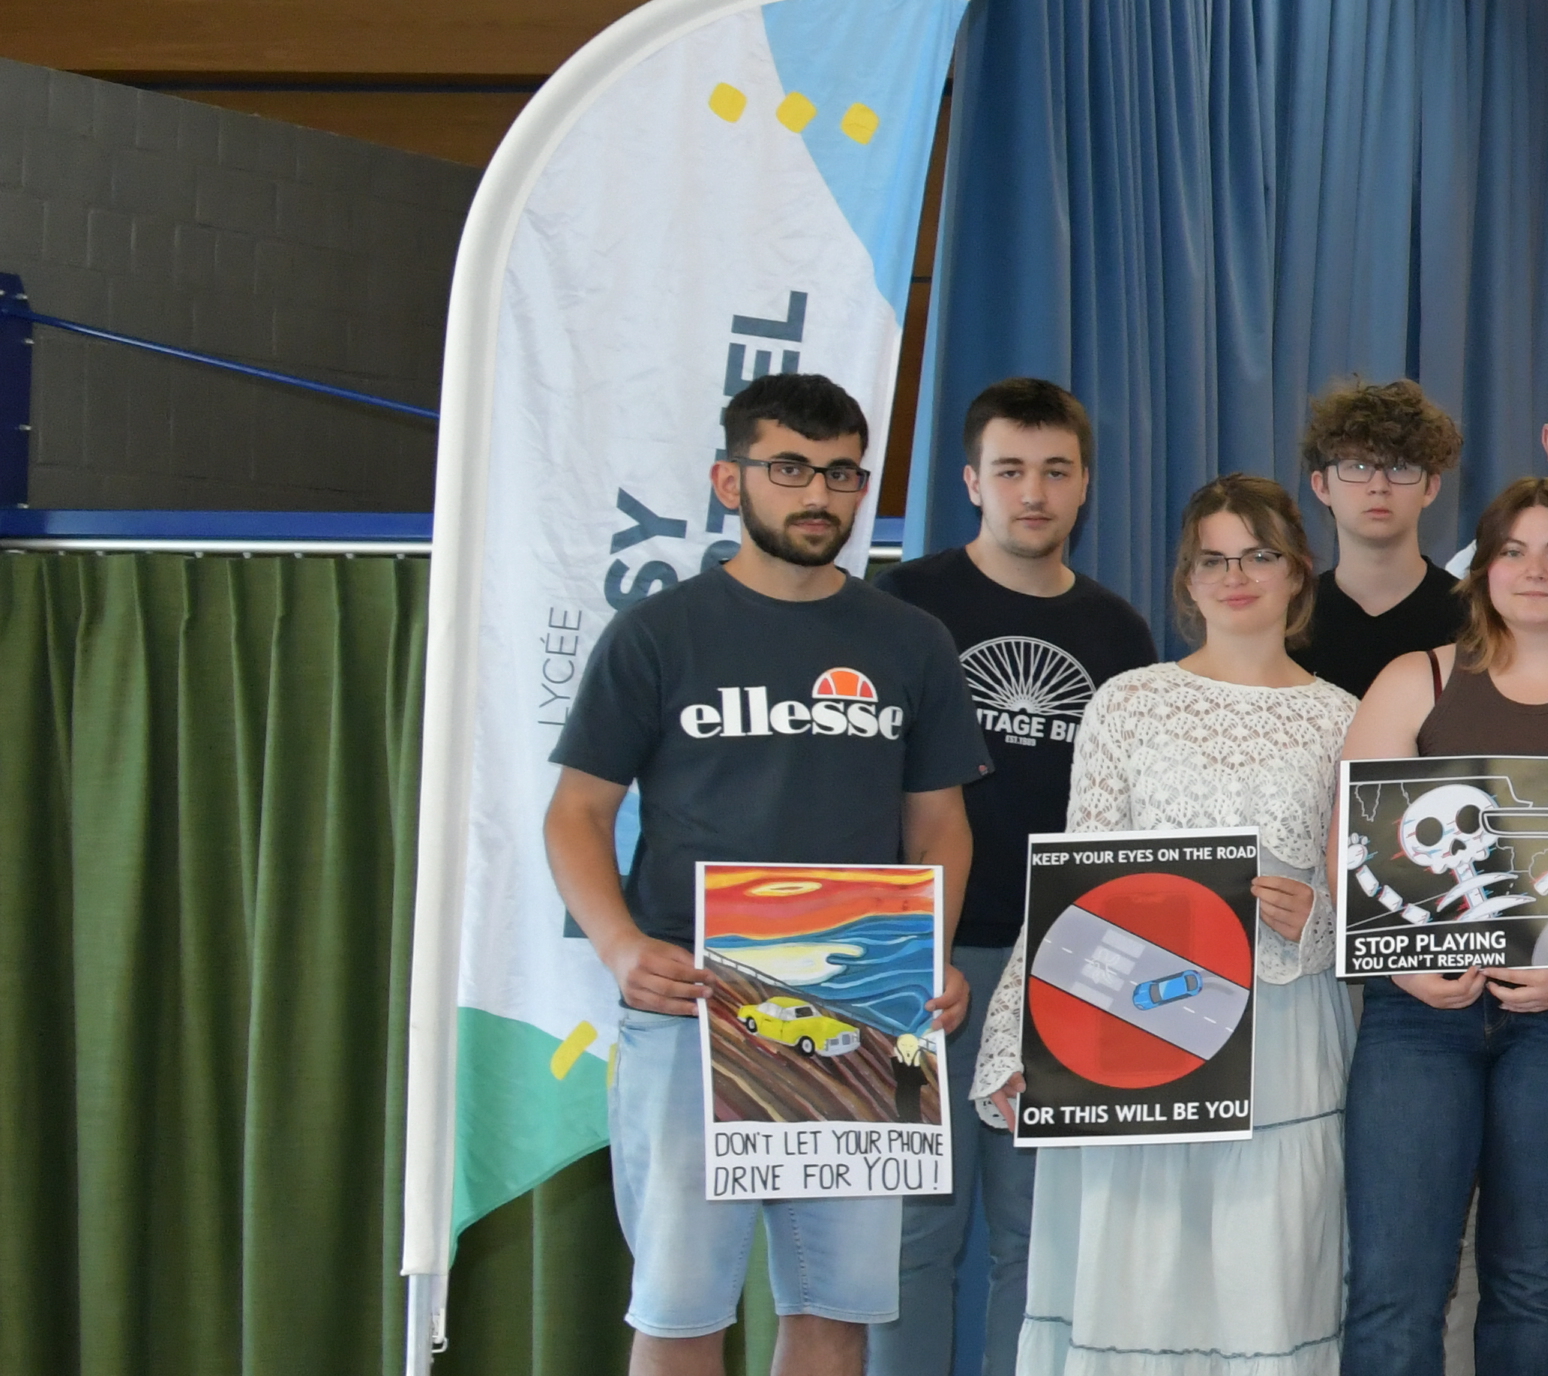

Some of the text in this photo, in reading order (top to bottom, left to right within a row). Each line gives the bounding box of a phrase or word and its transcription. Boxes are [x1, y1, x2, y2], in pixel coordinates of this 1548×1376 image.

[538, 606, 582, 727] LYCÉE
[679, 686, 903, 740] ellesse
[1050, 719, 1081, 743] BI
[1032, 845, 1257, 866] KEEP YOUR EYES ON THE ROAD
[1354, 930, 1507, 956] STOP PLAYING
[1352, 952, 1506, 970] YOU CAN'T RESPAWN
[1023, 1099, 1249, 1125] OR THIS WILL BE YOU
[715, 1129, 944, 1157] DON'T LET YOUR PHONE
[713, 1164, 784, 1197] DRIVE
[803, 1163, 852, 1190] FOR
[863, 1156, 923, 1191] YOU
